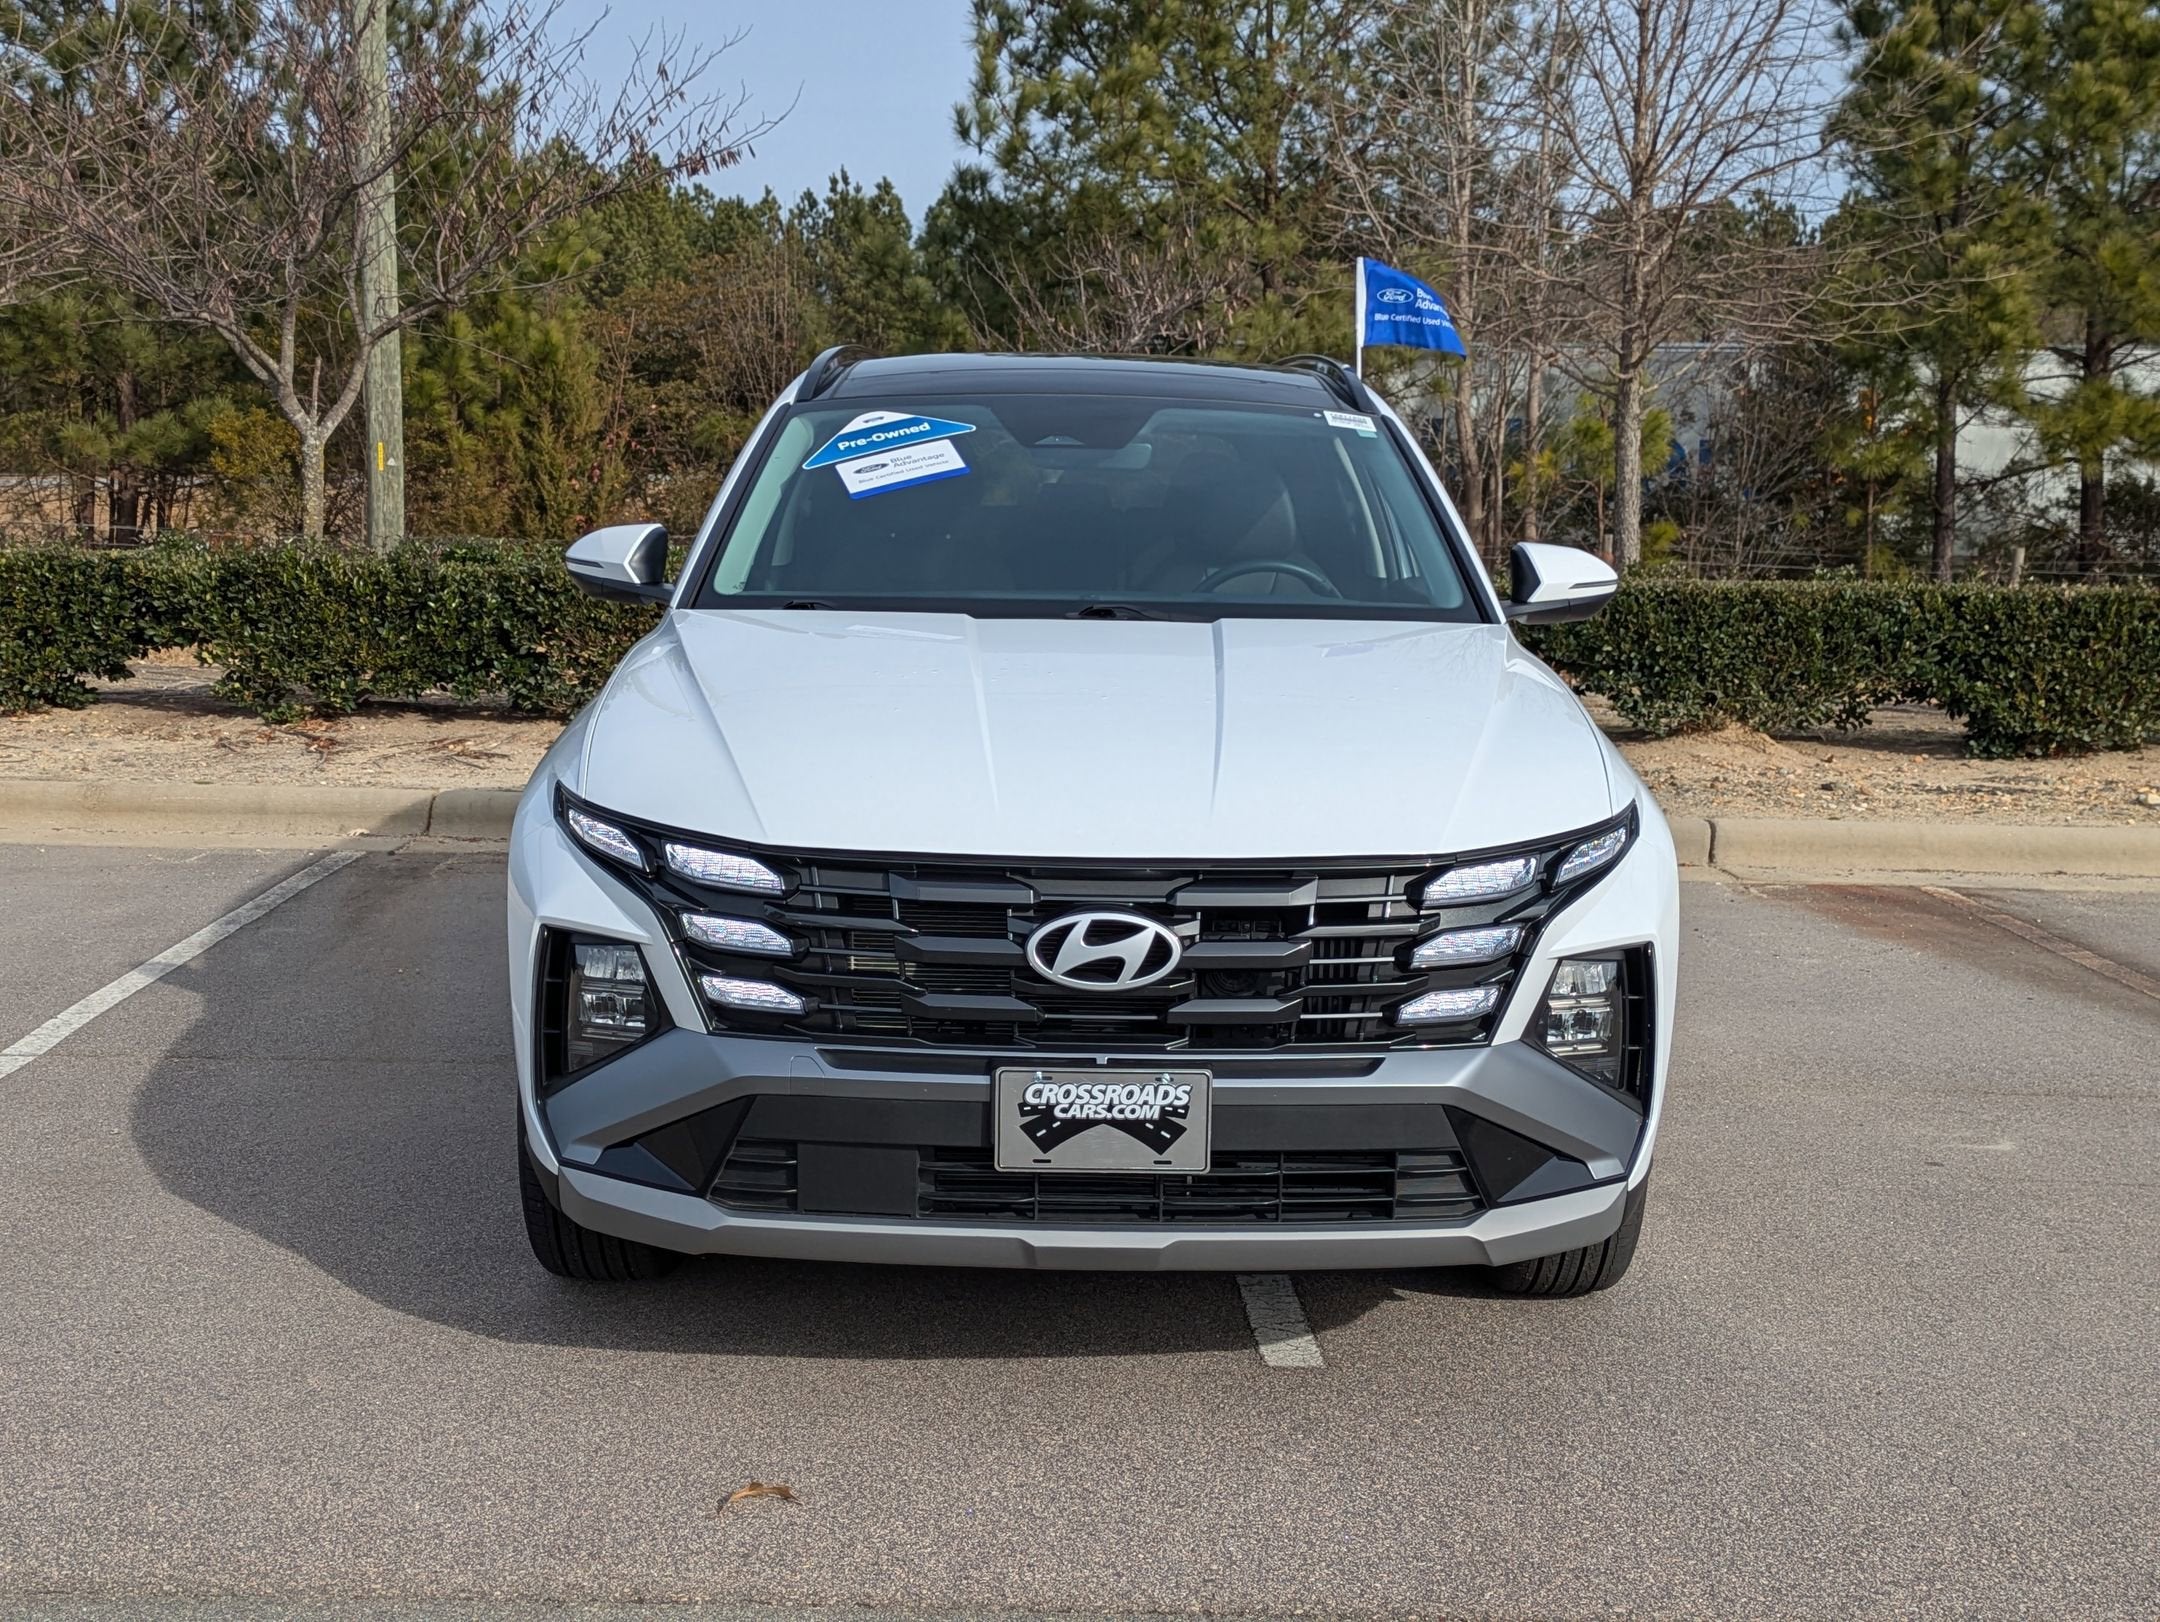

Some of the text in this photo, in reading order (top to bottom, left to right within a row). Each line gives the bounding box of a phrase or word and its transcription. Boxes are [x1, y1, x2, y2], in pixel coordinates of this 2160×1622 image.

[1374, 312, 1390, 321] Blue
[1390, 313, 1421, 324] Certified
[1422, 316, 1441, 326] Used
[837, 422, 931, 451] Pre-Owned
[890, 454, 912, 464] Blue
[893, 453, 945, 468] Advantage
[875, 470, 905, 480] Certified
[905, 465, 924, 473] Used
[1024, 1083, 1192, 1106] CROSSROADS
[1053, 1104, 1161, 1120] CARS.COM
